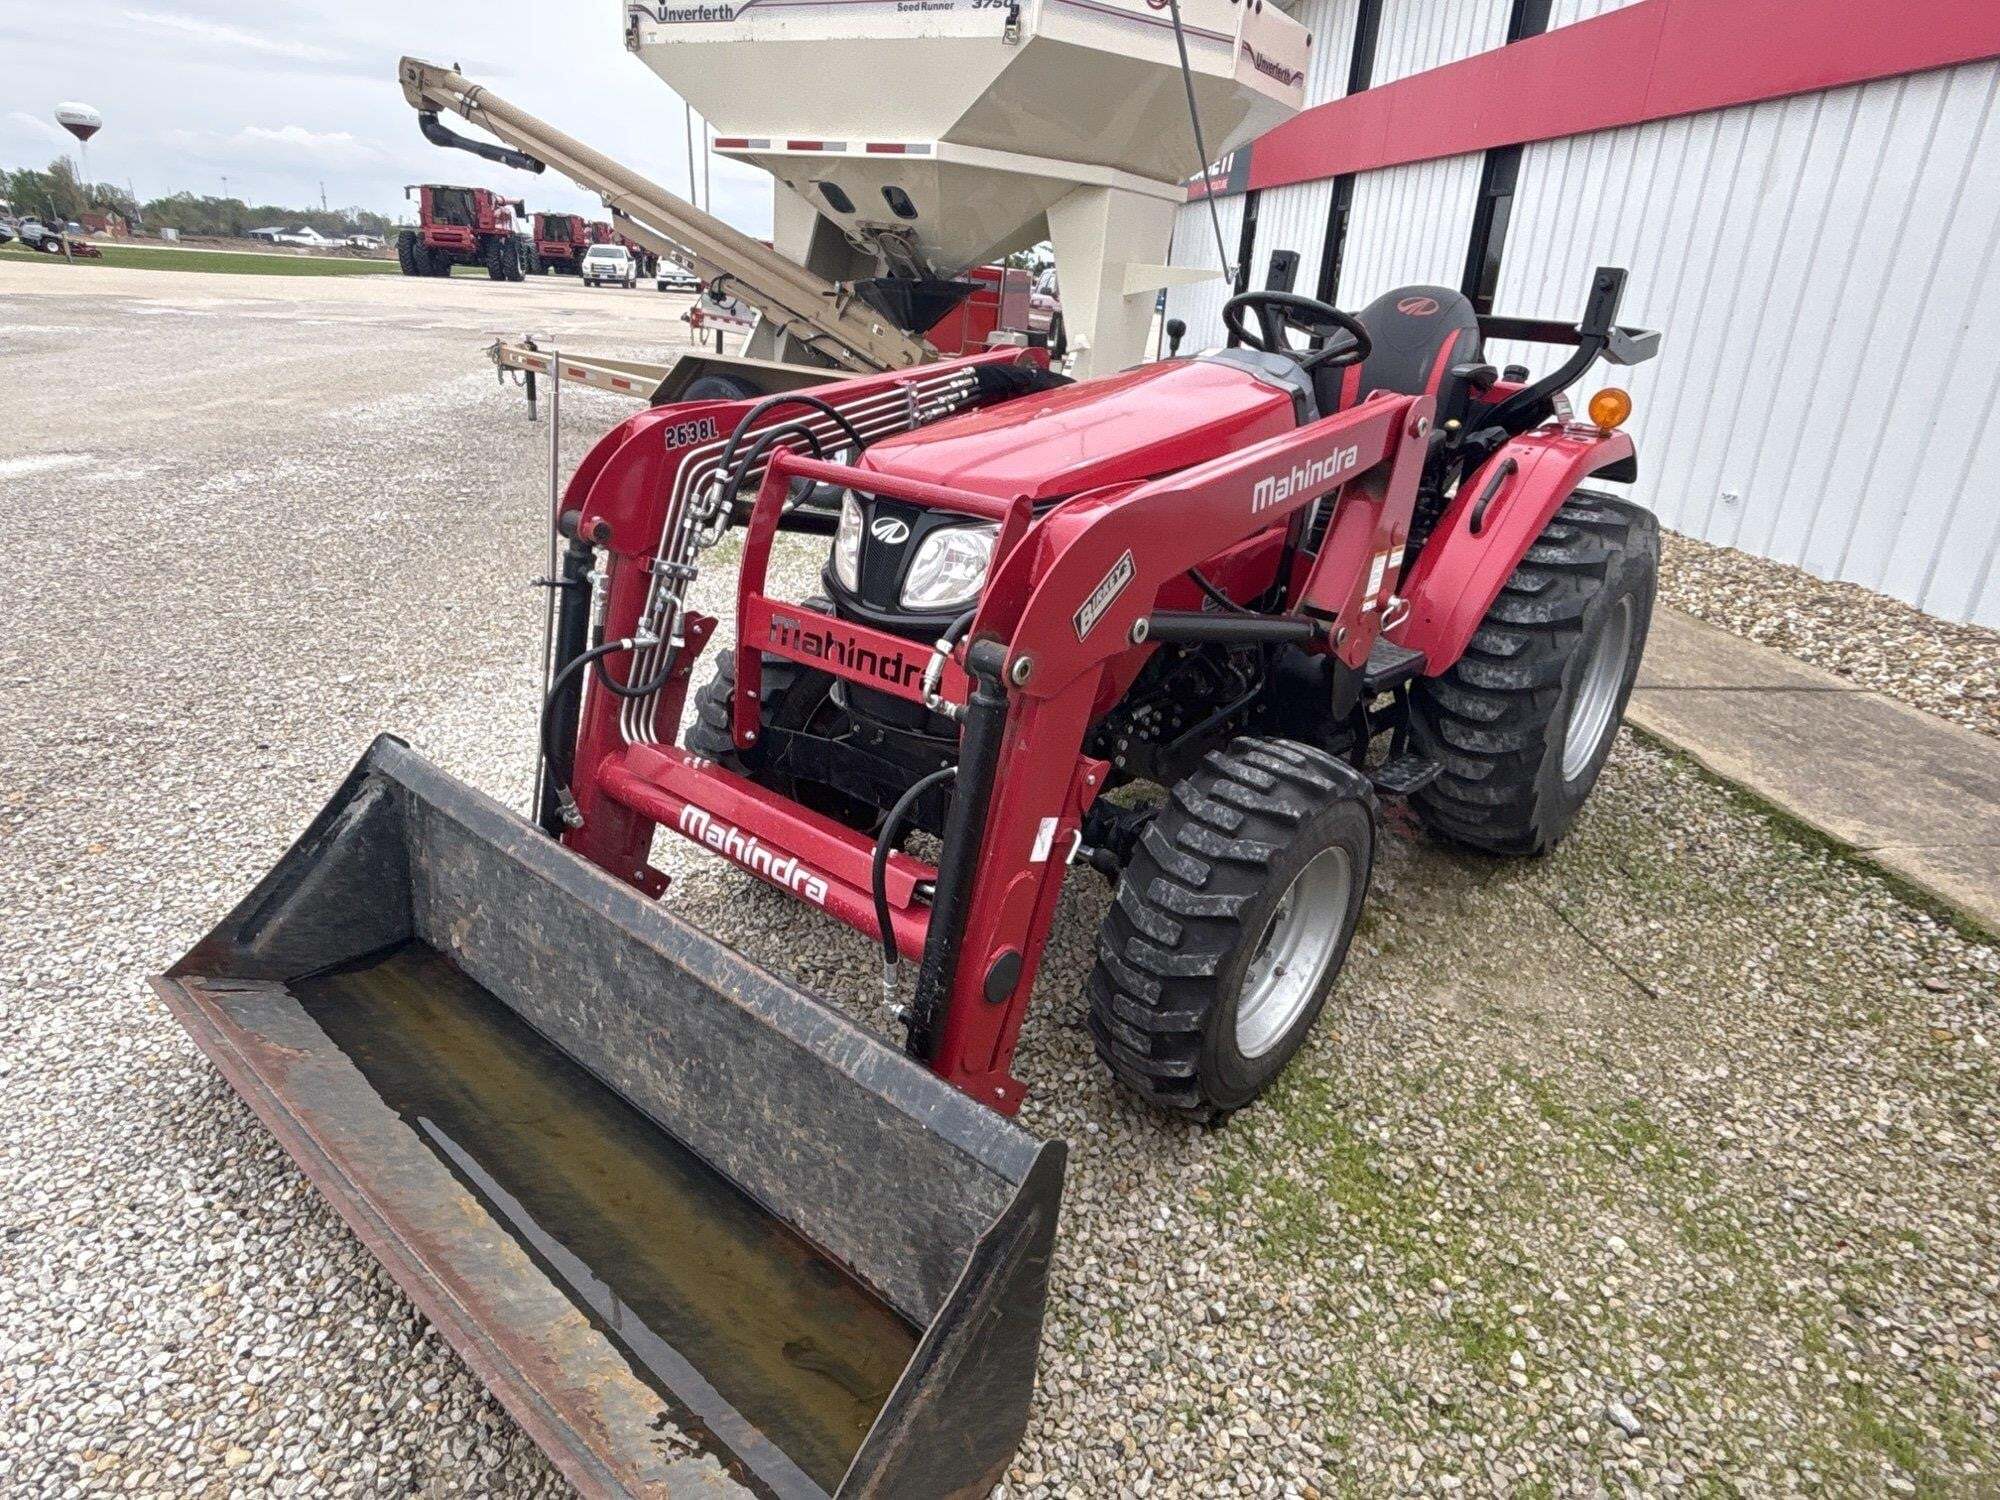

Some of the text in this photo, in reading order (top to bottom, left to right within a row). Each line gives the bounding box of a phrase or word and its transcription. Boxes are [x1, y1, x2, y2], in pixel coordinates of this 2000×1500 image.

[658, 4, 734, 21] Unverferth
[897, 2, 955, 12] Seed Runner
[1256, 52, 1291, 83] Unverferth
[665, 417, 719, 450] 2638L
[1252, 444, 1358, 514] Mahindra
[679, 804, 828, 906] Mahindra
